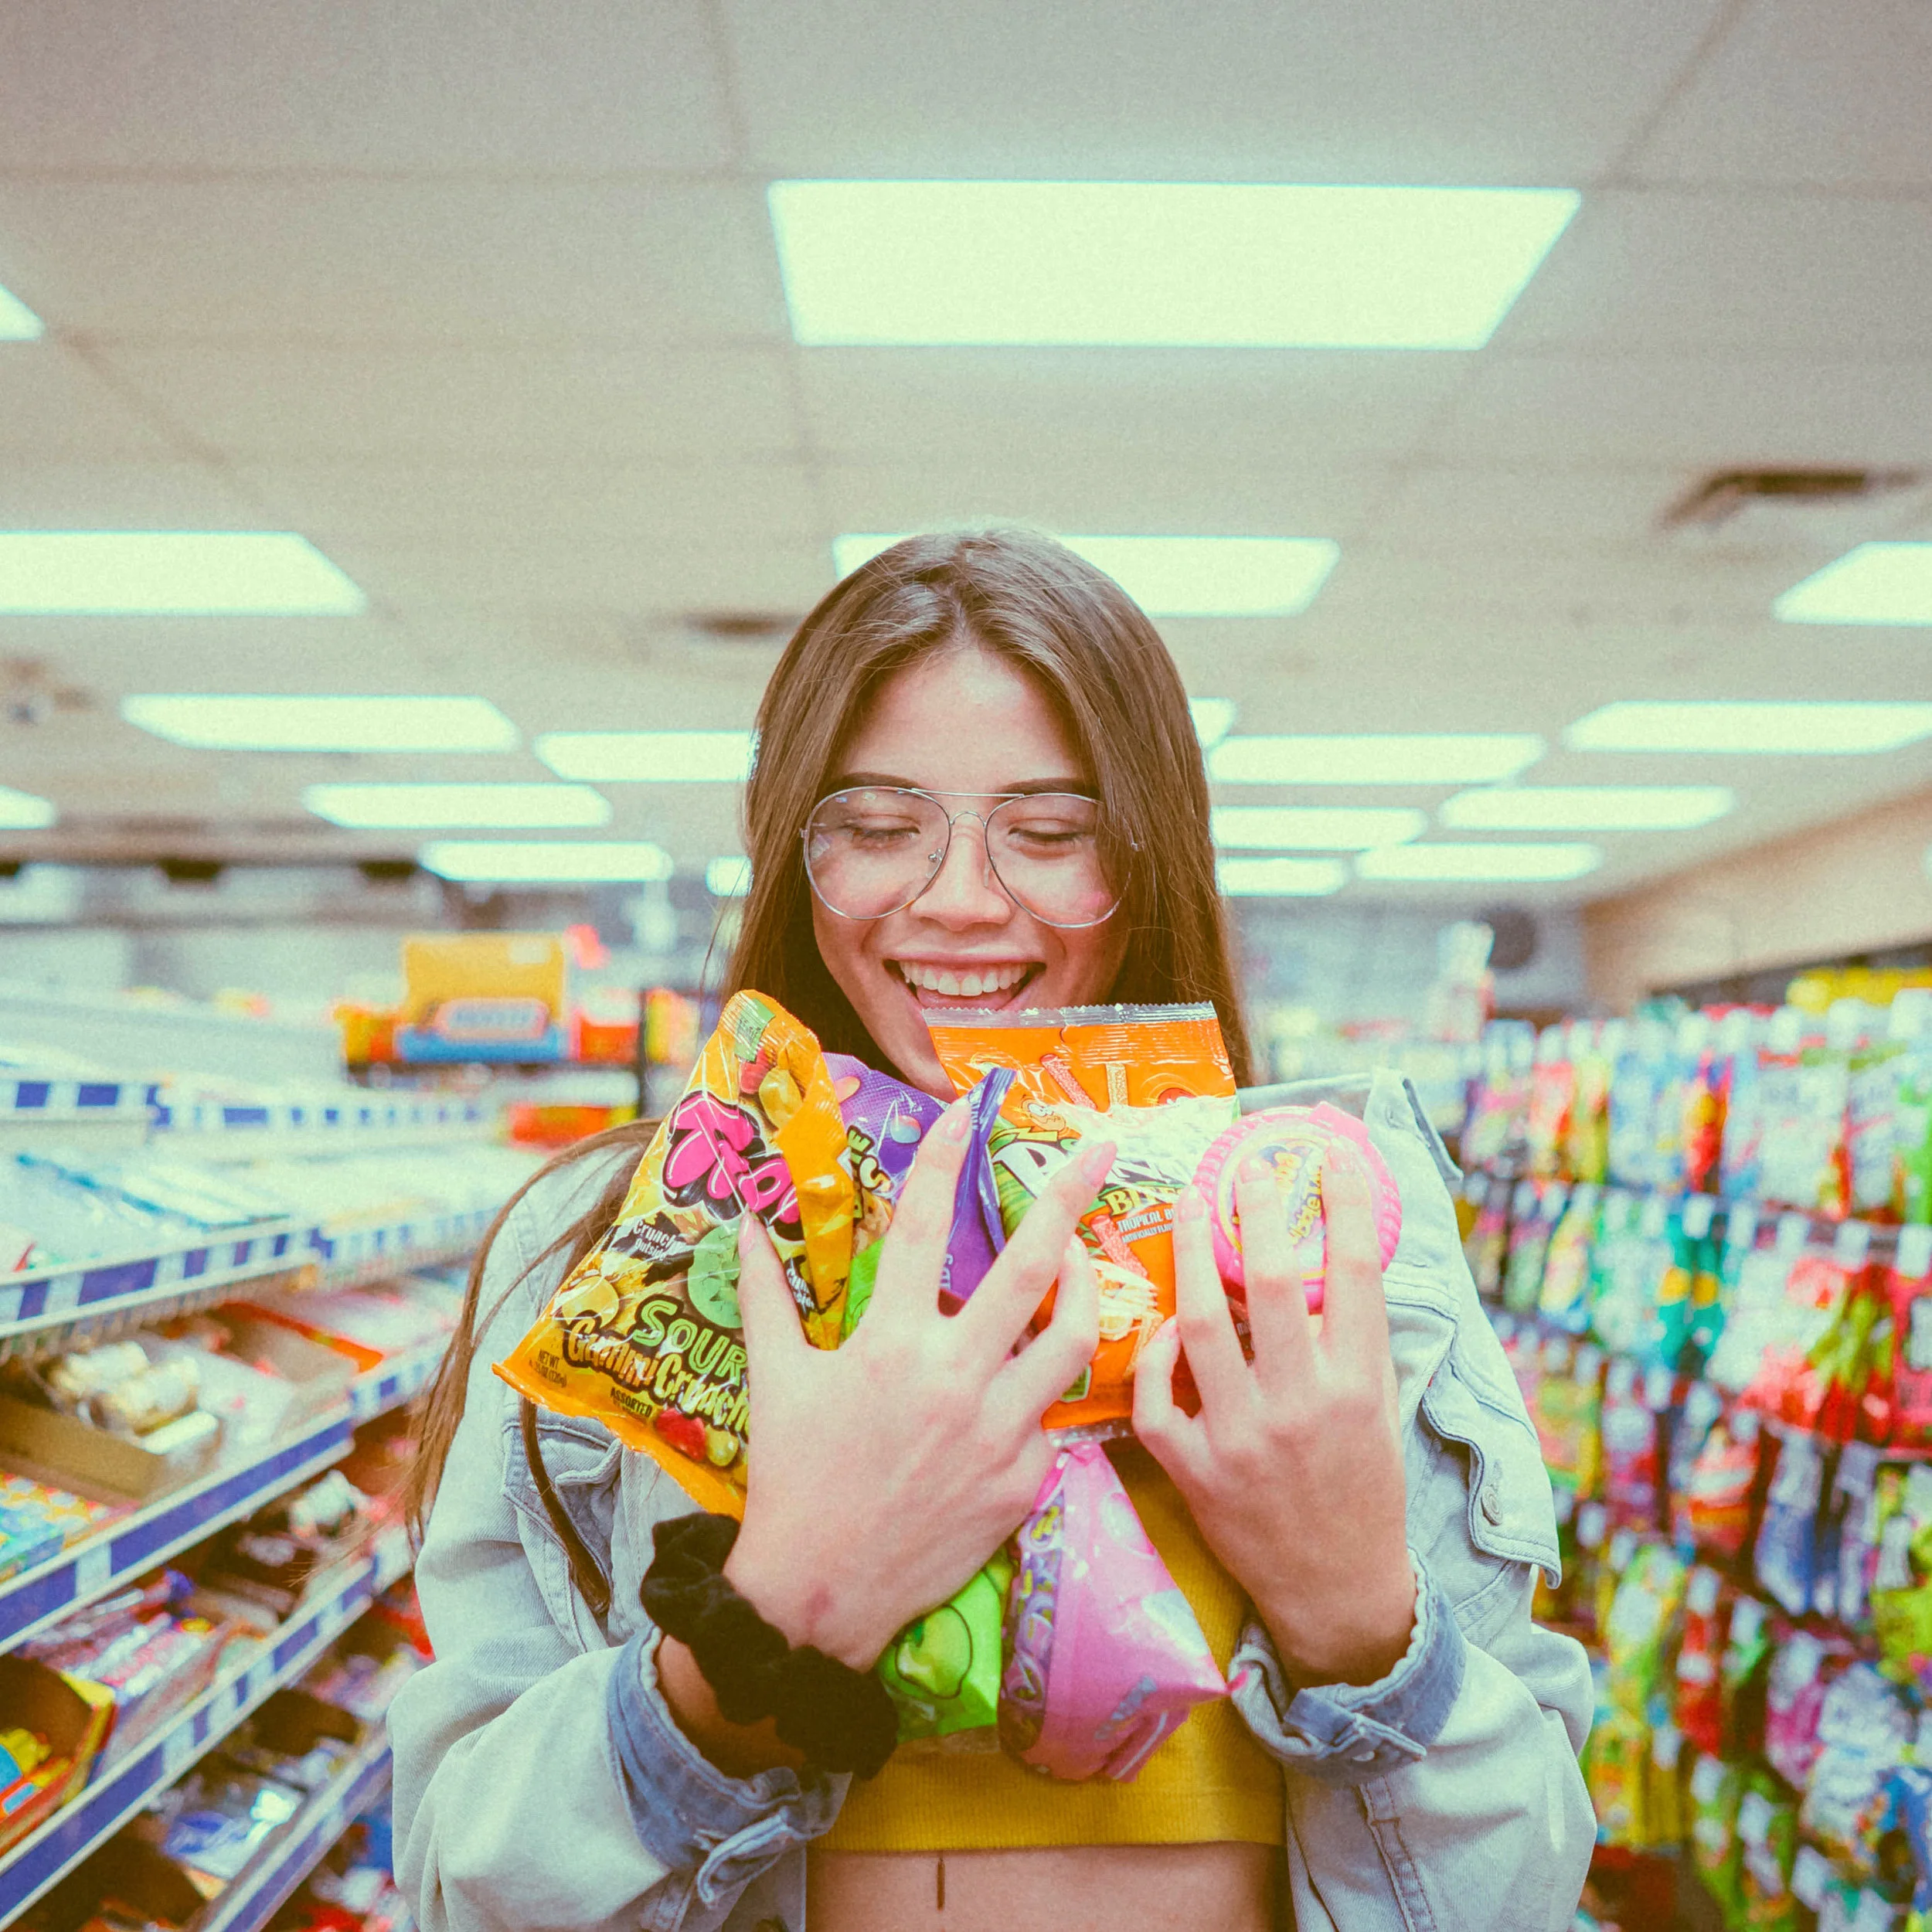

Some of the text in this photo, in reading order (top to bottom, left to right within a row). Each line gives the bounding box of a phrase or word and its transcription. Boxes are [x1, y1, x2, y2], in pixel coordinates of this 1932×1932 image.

[1116, 1209, 1164, 1233] TROPICAL
[634, 1237, 667, 1262] Outside
[549, 1355, 560, 1369] WT
[568, 1316, 750, 1437] Gummi Crunch
[610, 1386, 653, 1417] ASSORTED
